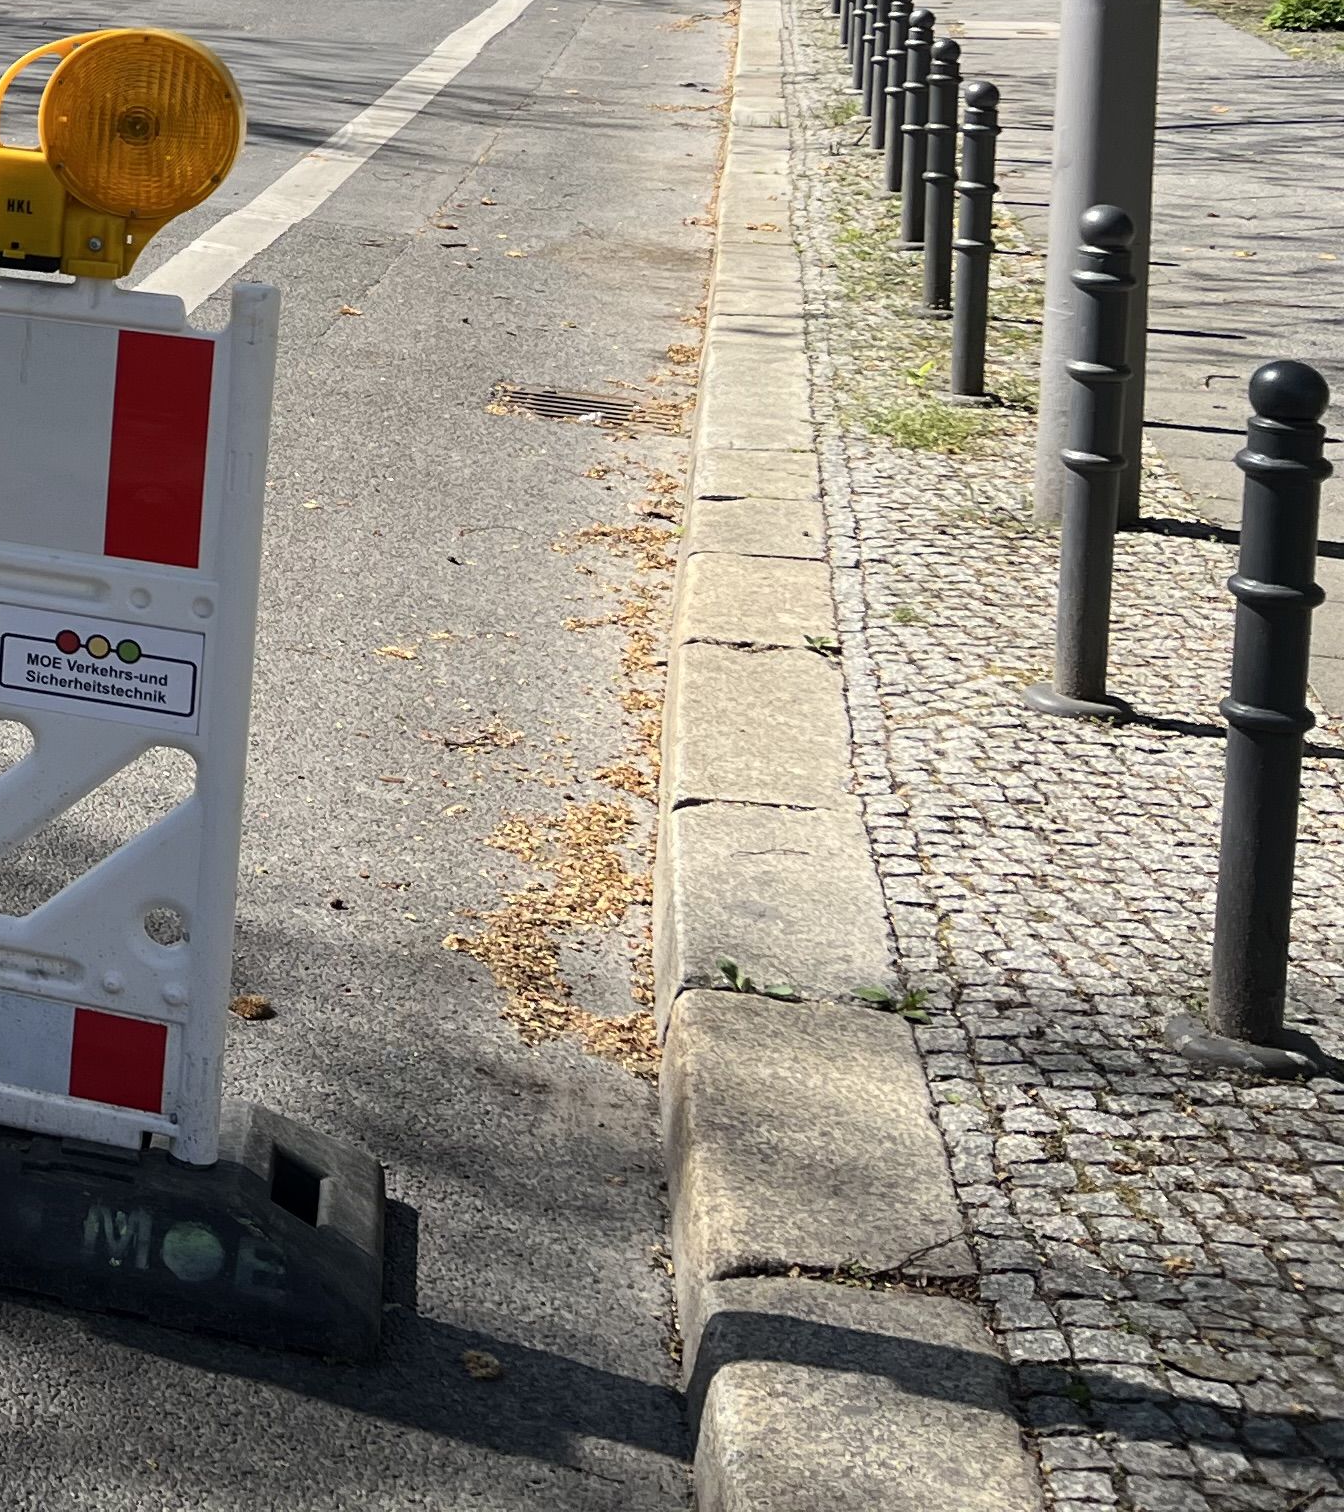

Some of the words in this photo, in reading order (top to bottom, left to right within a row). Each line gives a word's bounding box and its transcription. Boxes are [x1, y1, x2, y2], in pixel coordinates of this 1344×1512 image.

[6, 198, 33, 215] HKL
[26, 652, 62, 670] MOE
[67, 659, 168, 687] Verkehrs-und
[25, 670, 167, 704] Sicherheitstechnik
